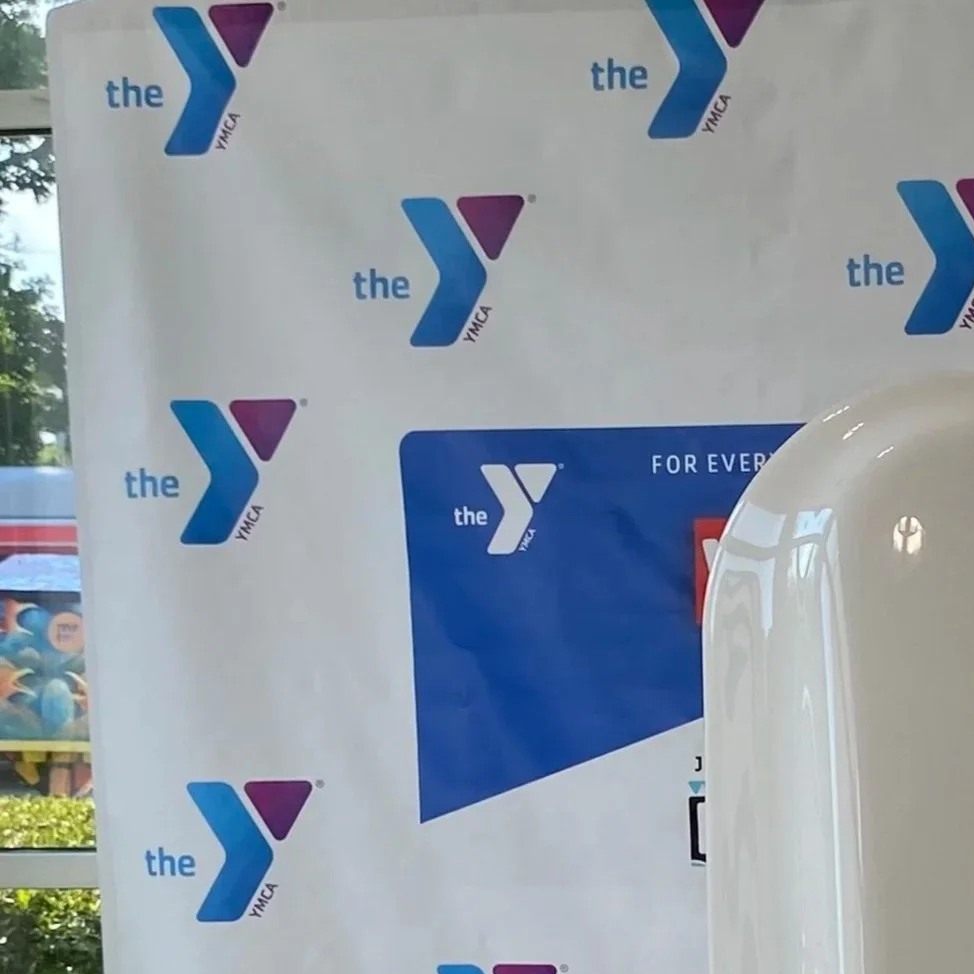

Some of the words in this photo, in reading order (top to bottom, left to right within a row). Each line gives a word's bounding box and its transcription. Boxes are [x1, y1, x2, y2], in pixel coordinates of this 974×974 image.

[591, 58, 647, 91] the
[106, 77, 163, 108] the
[702, 95, 731, 133] YMCA
[216, 113, 240, 150] YMCA
[353, 268, 410, 299] the
[847, 254, 904, 287] the
[463, 306, 492, 342] YMCA
[652, 455, 697, 474] FOR
[708, 453, 774, 472] EVER
[125, 468, 179, 498] the
[235, 505, 264, 540] YMCA
[454, 506, 488, 526] the
[518, 528, 536, 552] YMCA
[145, 847, 195, 877] the
[249, 883, 278, 917] YMCA
